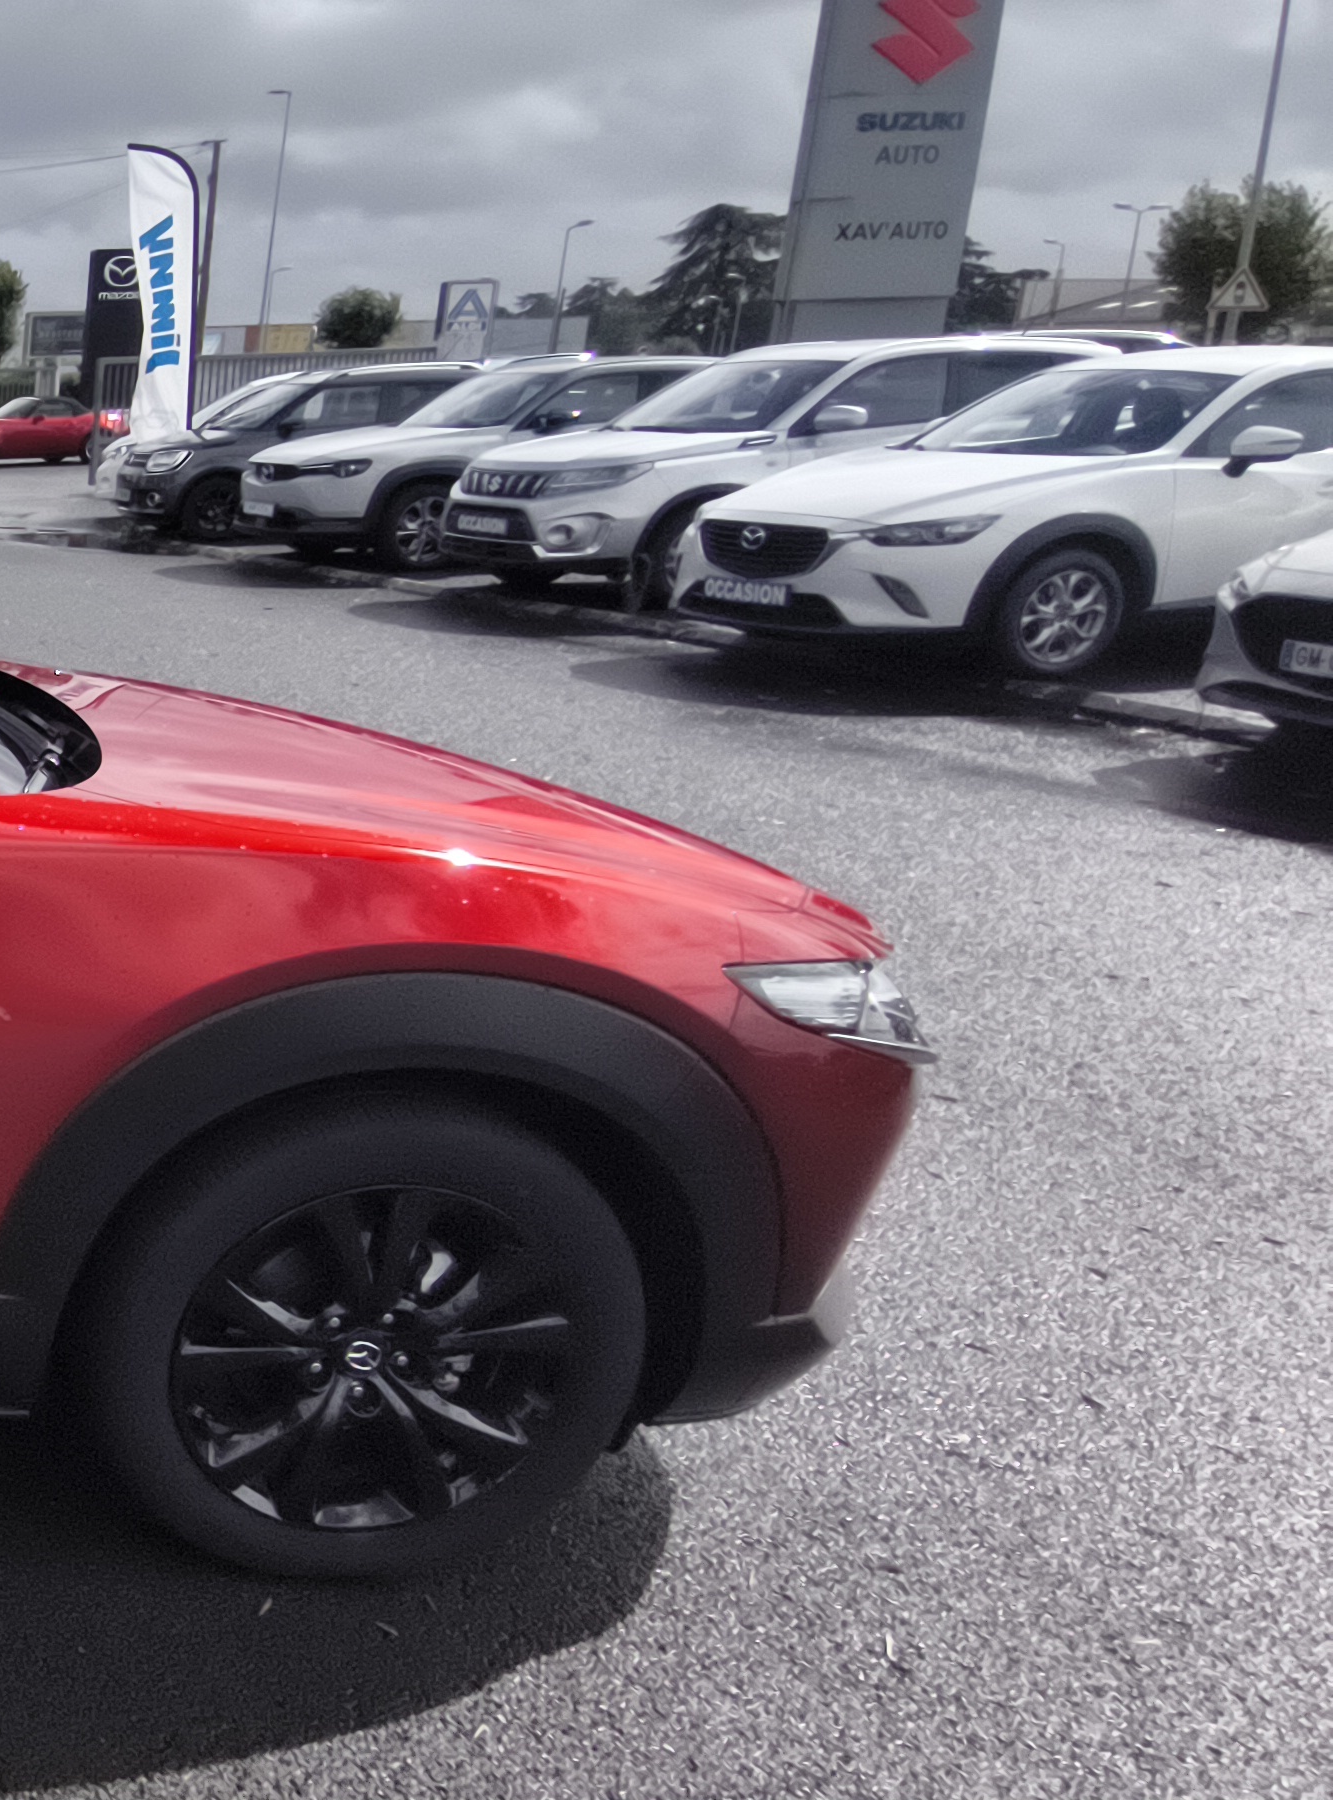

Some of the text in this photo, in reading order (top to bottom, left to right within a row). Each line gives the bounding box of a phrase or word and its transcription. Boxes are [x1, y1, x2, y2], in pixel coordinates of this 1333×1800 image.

[856, 111, 966, 132] SUZUKI
[874, 145, 940, 165] AUTO
[834, 220, 949, 241] XAV'AUTO
[704, 577, 787, 606] OCCASION
